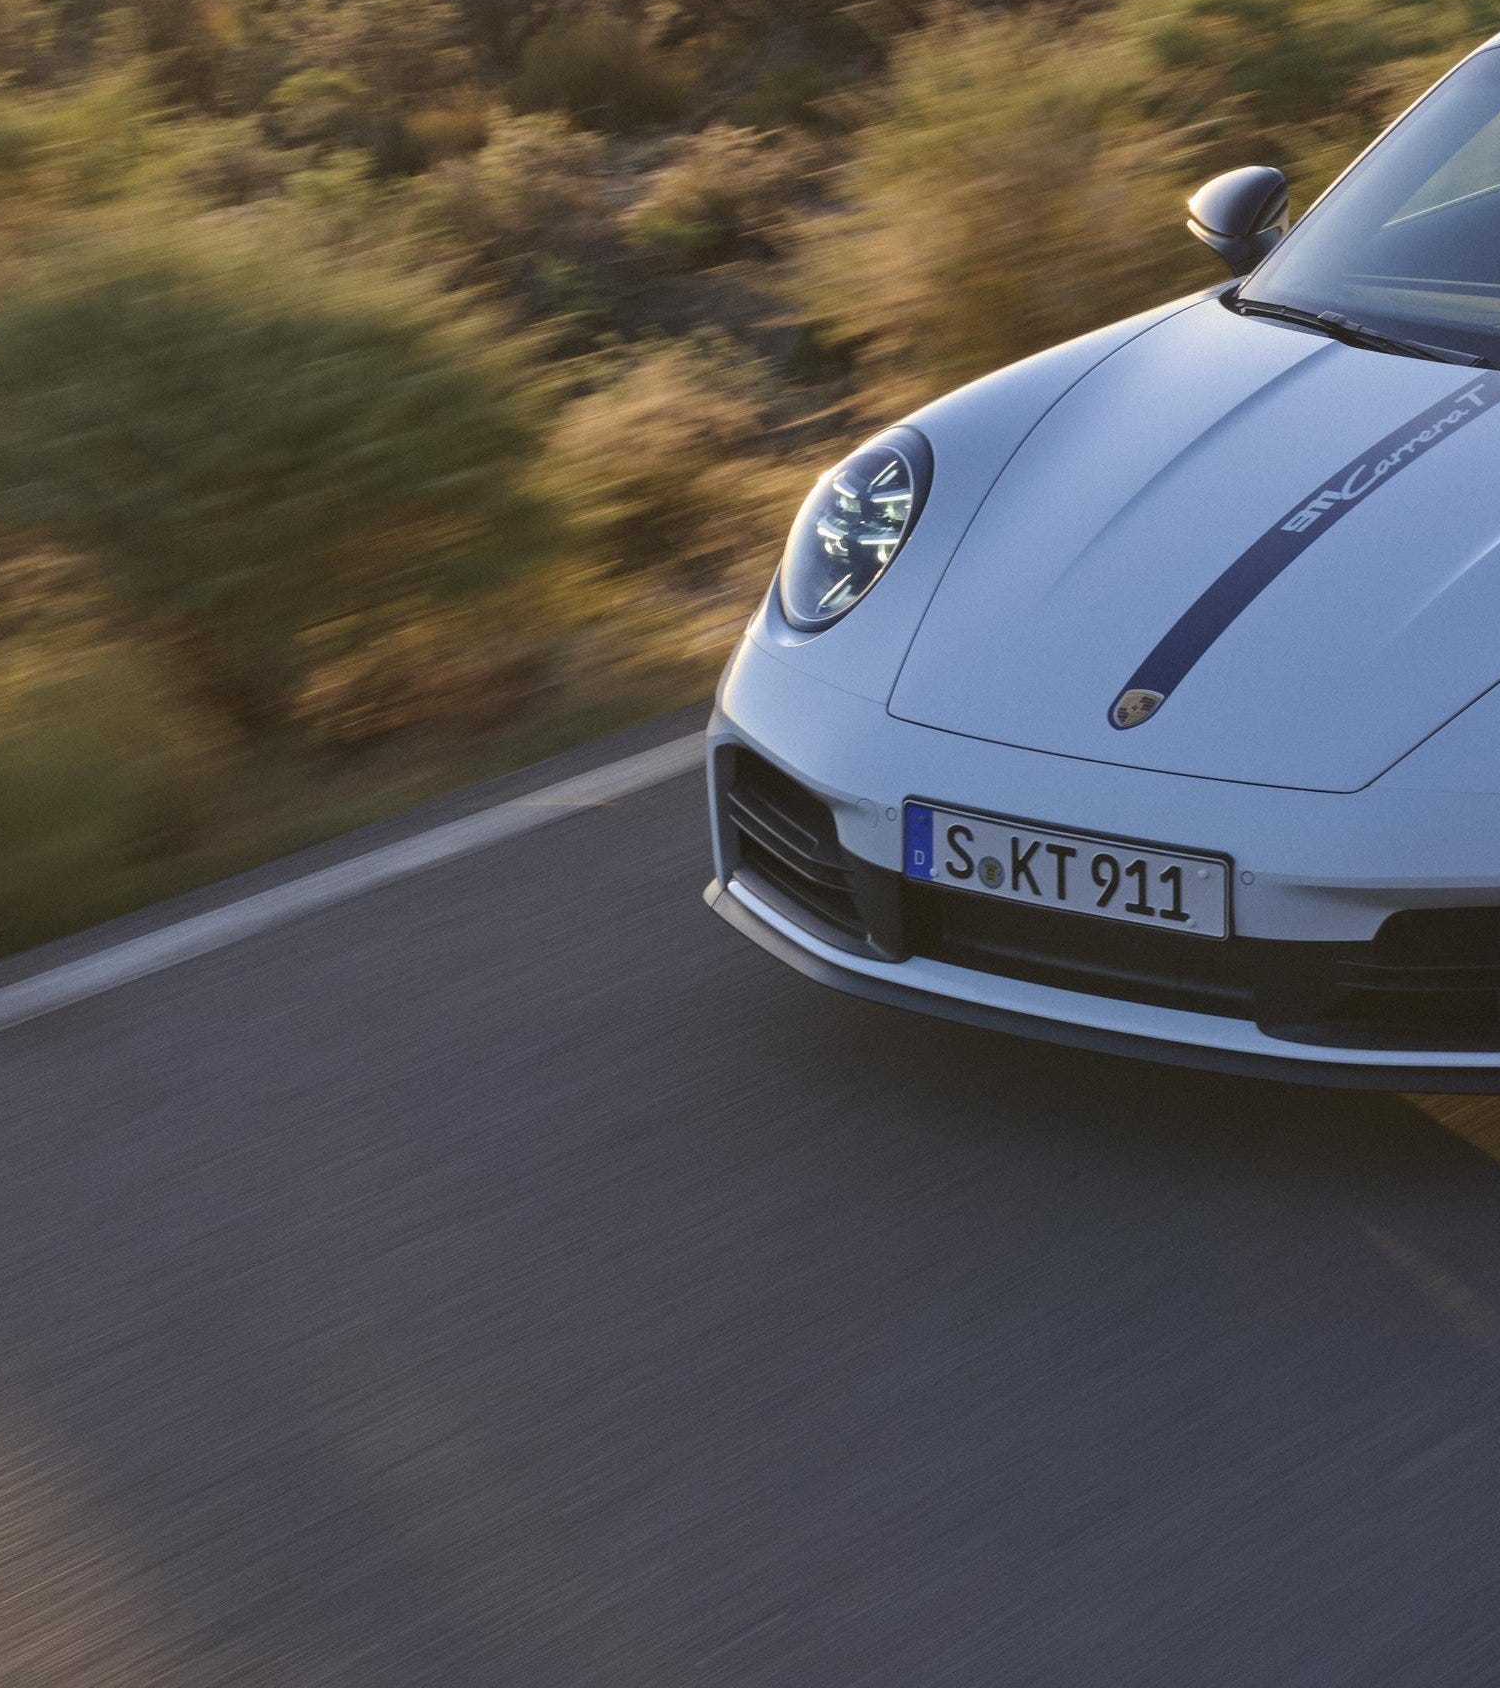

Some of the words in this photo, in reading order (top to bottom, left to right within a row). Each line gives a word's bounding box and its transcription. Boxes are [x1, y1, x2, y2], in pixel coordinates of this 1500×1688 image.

[1341, 409, 1469, 501] Carrera
[1455, 383, 1485, 406] T
[915, 850, 925, 865] D
[945, 823, 975, 879] S
[1011, 836, 1077, 900] KT
[1091, 853, 1191, 922] 911
